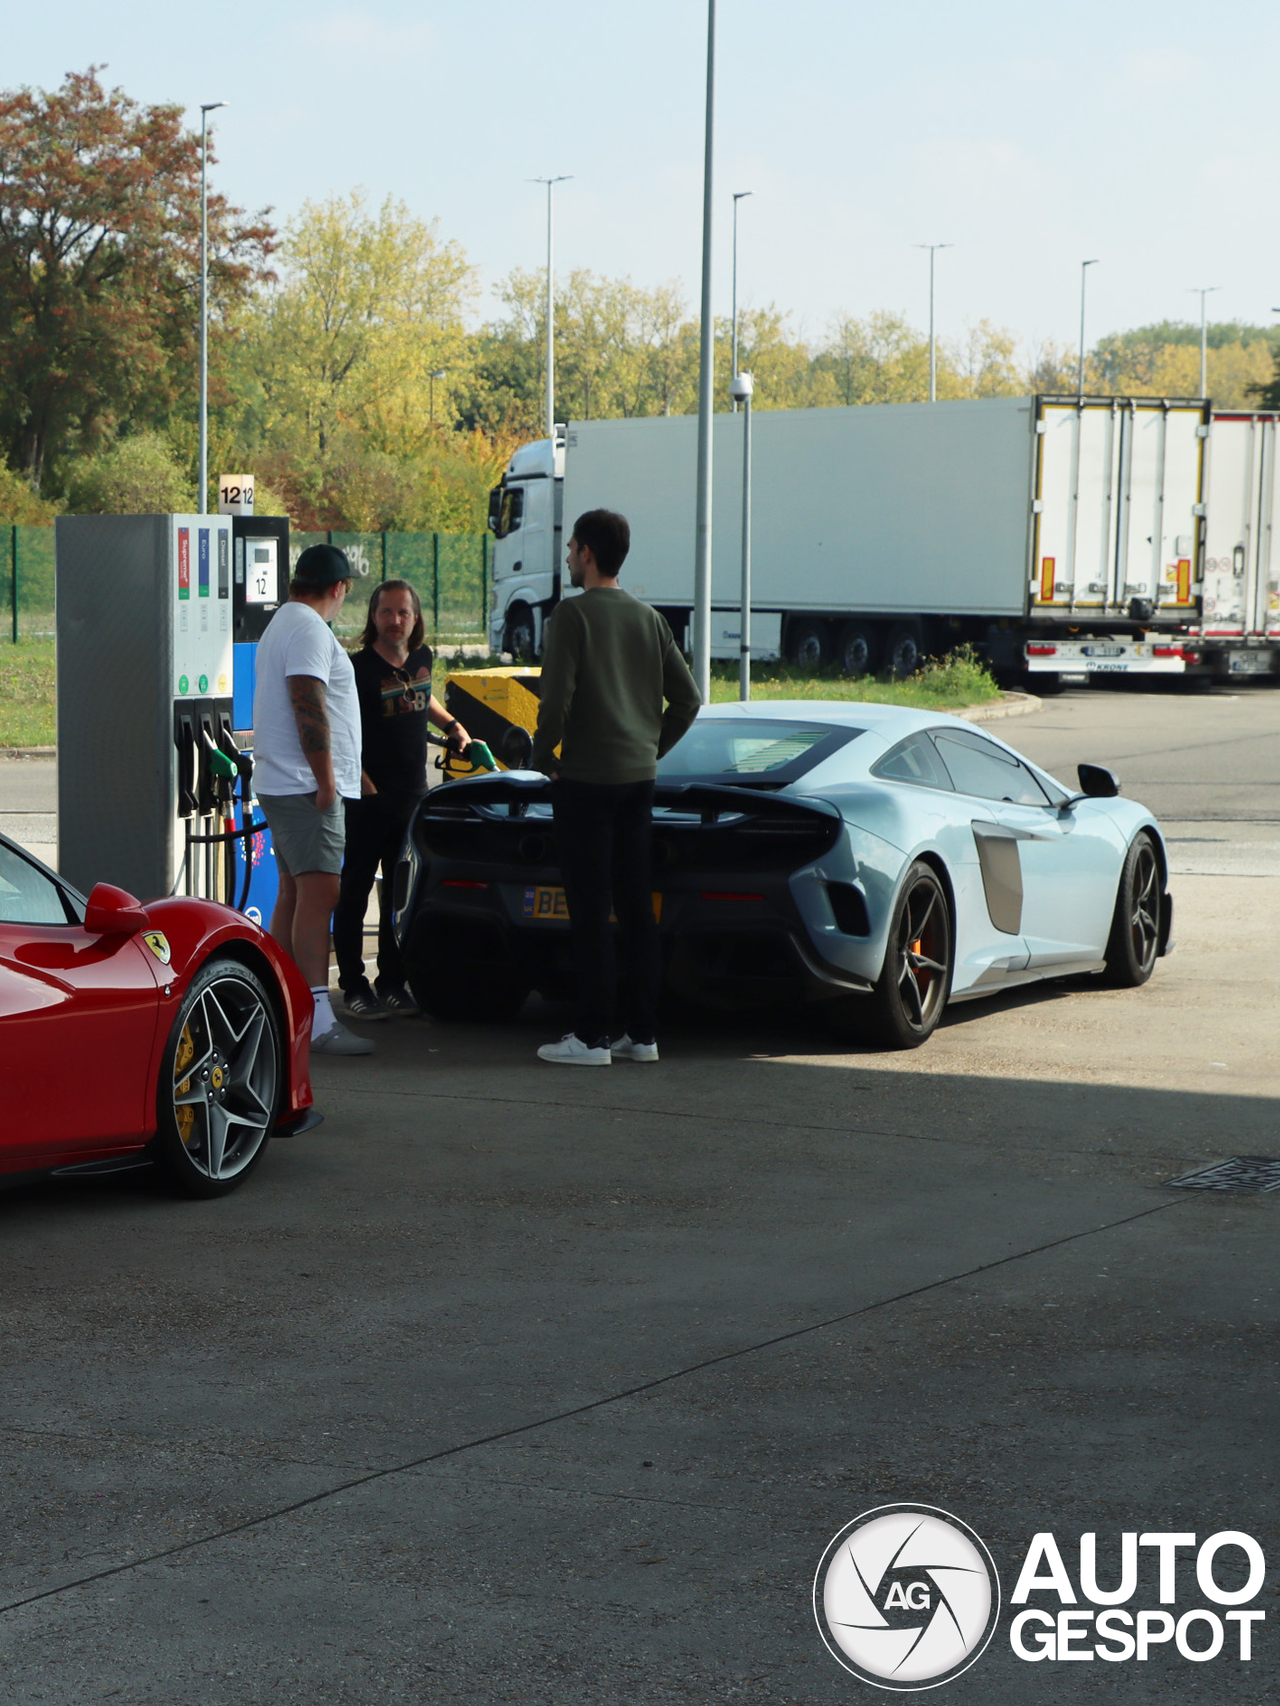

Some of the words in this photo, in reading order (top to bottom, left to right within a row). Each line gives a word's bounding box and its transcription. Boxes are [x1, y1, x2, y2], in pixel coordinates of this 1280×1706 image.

[221, 487, 241, 504] 12
[243, 488, 253, 504] 12
[256, 578, 266, 595] 12
